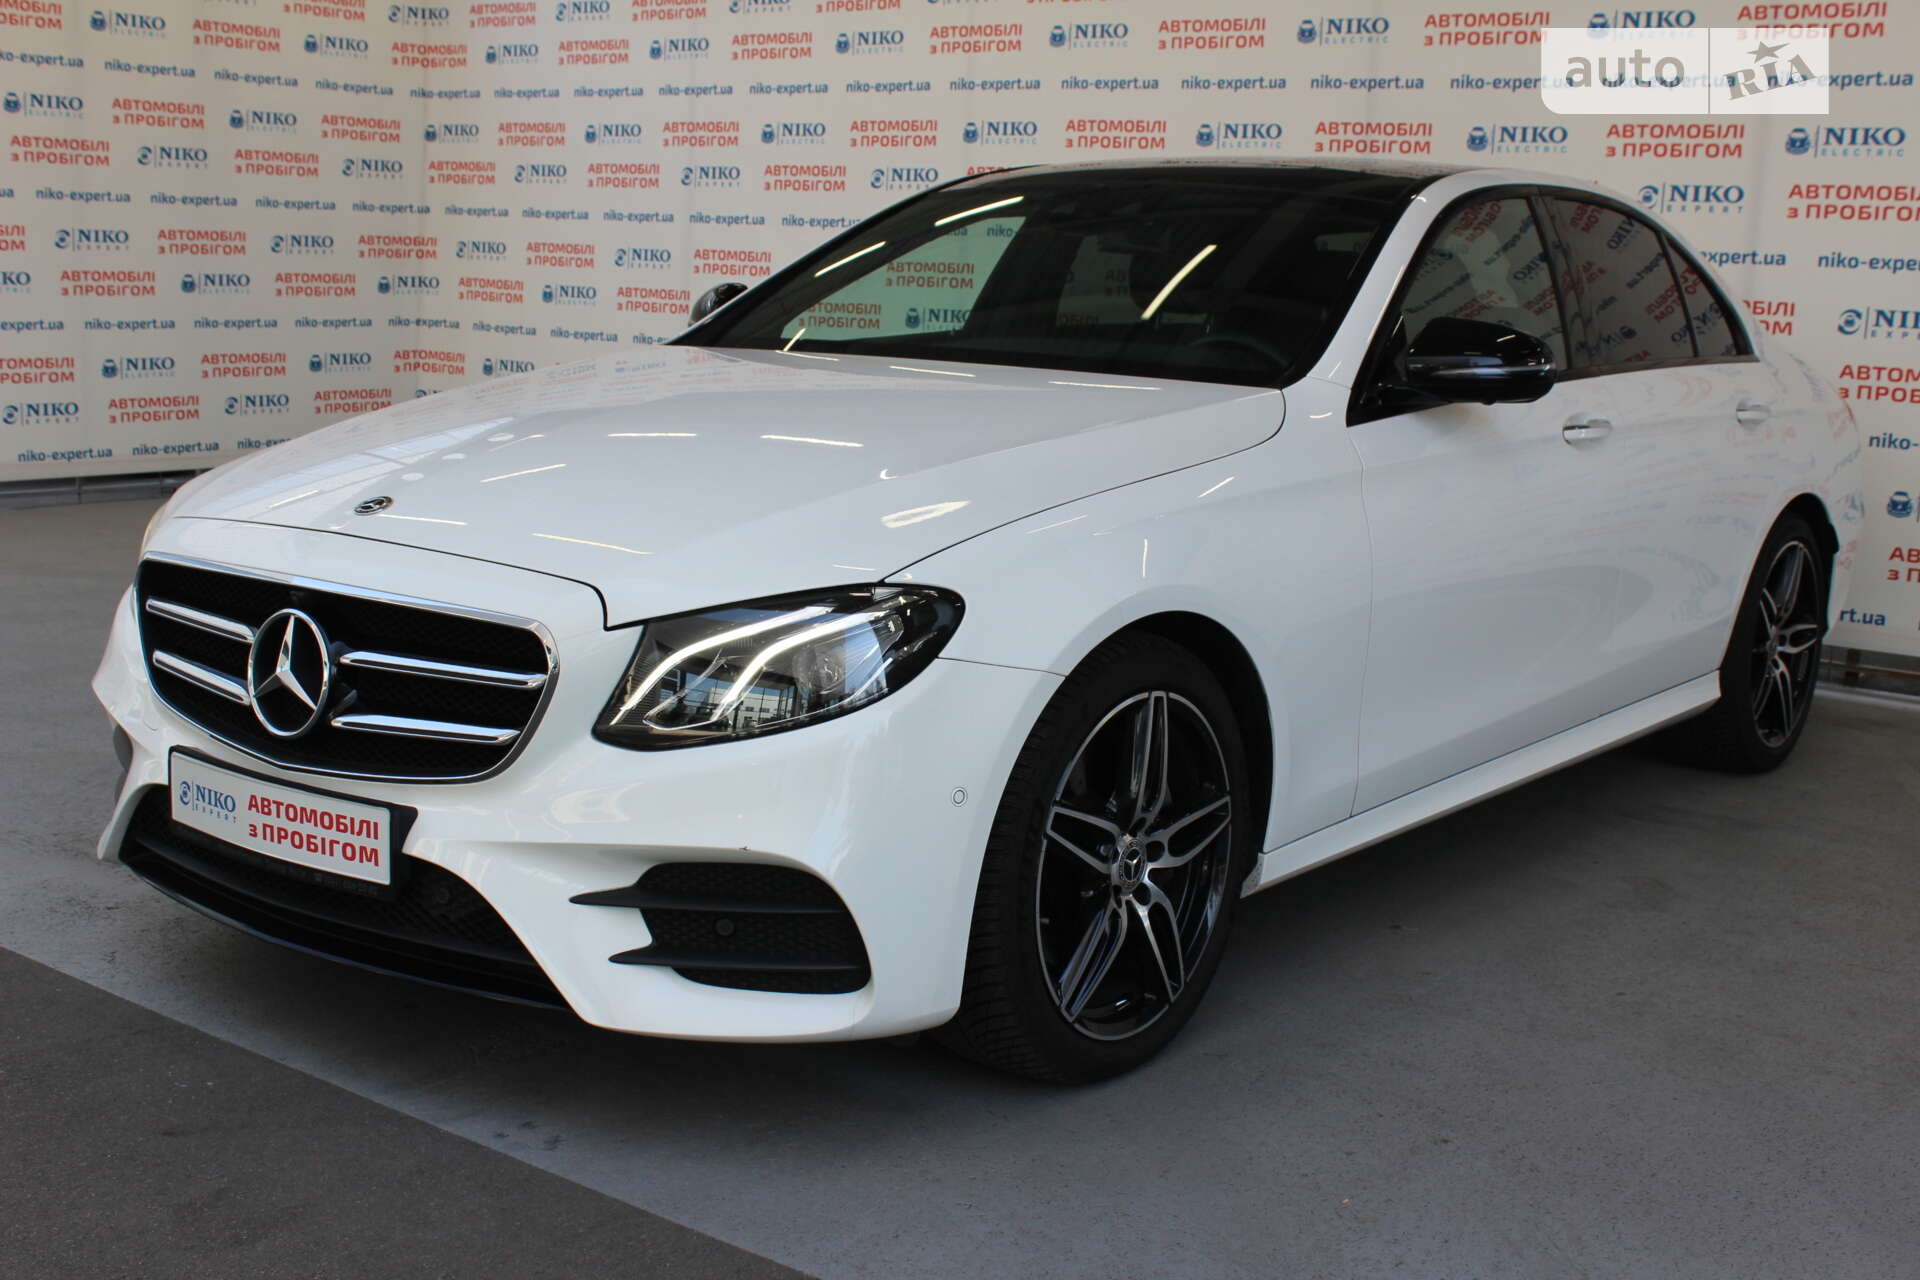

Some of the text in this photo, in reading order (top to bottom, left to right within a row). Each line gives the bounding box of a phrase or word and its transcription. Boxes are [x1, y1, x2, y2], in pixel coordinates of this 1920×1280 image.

[293, 3, 365, 22] ПРОБІГОМ
[407, 7, 450, 20] NIKO
[469, 2, 536, 16] АВТОМОБІЛІ
[571, 1, 610, 14] NIKO
[640, 7, 706, 21] ПРОБІГОМ
[1737, 1, 1887, 21] АВТОМОБІЛІ
[116, 13, 166, 30] NIKO
[477, 15, 536, 28] ПРОБІГОМ
[1158, 17, 1266, 33] АВТОМОБІЛІ
[1327, 18, 1389, 34] NIKO
[1424, 11, 1550, 28] АВТОМОБІЛІ
[1622, 10, 1696, 28] NIKO
[193, 19, 280, 40] АВТОМОБІЛІ
[929, 24, 1023, 39] АВТОМОБІЛІ
[1075, 23, 1128, 39] NIKO
[204, 34, 280, 52] ПРОБІГОМ
[326, 36, 368, 52] NIKO
[669, 38, 709, 52] NIKO
[732, 32, 813, 46] АВТОМОБІЛІ
[858, 30, 904, 46] NIKO
[1171, 34, 1264, 50] ПРОБІГОМ
[1424, 30, 1547, 47] з ПРОБІГОМ
[391, 42, 468, 56] АВТОМОБІЛІ
[502, 44, 539, 57] NIKO
[558, 39, 630, 52] АВТОМОБІЛІ
[941, 39, 1022, 54] ПРОБІГОМ
[566, 52, 629, 65] ПРОБІГОМ
[741, 47, 812, 60] ПРОБІГОМ
[104, 59, 195, 78] niko-expert.ua
[401, 55, 467, 69] ПРОБІГОМ
[214, 69, 298, 88] niko-expert.ua
[949, 78, 1040, 93] niko-expert.ua
[1061, 76, 1159, 93] niko-expert.ua
[1181, 76, 1286, 92] niko-expert.ua
[1310, 74, 1424, 92] niko-expert.ua
[315, 79, 393, 96] niko-expert.ua
[659, 85, 733, 98] niko-expert.ua
[749, 82, 828, 96] niko-expert.ua
[846, 80, 931, 95] niko-expert.ua
[30, 94, 83, 111] NIKO
[112, 98, 205, 115] АВТОМОБІЛІ
[124, 113, 204, 129] ПРОБІГОМ
[252, 111, 297, 126] NIKO
[321, 114, 401, 130] АВТОМОБІЛІ
[444, 124, 479, 137] NIKO
[498, 122, 566, 134] АВТОМОБІЛІ
[603, 124, 642, 137] NIKO
[662, 120, 740, 134] АВТОМОБІЛІ
[782, 123, 826, 137] NIKO
[850, 119, 938, 133] АВТОМОБІЛІ
[987, 121, 1037, 136] NIKO
[1065, 119, 1167, 133] АВТОМОБІЛІ
[1224, 123, 1282, 139] NIKO
[1315, 121, 1433, 137] АВТОМОБІЛІ
[1606, 123, 1745, 139] АВТОМОБІЛІ
[331, 128, 400, 143] ПРОБІГОМ
[506, 135, 565, 147] ПРОБІГОМ
[672, 135, 739, 147] ПРОБІГОМ
[1500, 125, 1568, 143] NIKO
[1824, 127, 1906, 146] NIKO
[10, 135, 110, 152] АВТОМОБІЛІ
[860, 135, 937, 148] ПРОБІГОМ
[1077, 135, 1165, 150] ПРОБІГОМ
[1315, 139, 1431, 155] з ПРОБІГОМ
[24, 150, 110, 166] ПРОБІГОМ
[160, 147, 208, 161] NIKO
[235, 149, 319, 164] АВТОМОБІЛІ
[1605, 143, 1742, 159] з ПРОБІГОМ
[245, 163, 319, 177] ПРОБІГОМ
[361, 159, 403, 173] NIKO
[428, 161, 496, 172] АВТОМОБІЛІ
[530, 164, 567, 177] NIKO
[587, 163, 660, 175] АВТОМОБІЛІ
[699, 166, 740, 180] NIKO
[764, 164, 847, 177] АВТОМОБІЛІ
[438, 173, 496, 185] ПРОБІГОМ
[892, 168, 939, 182] NIKO
[595, 176, 659, 189] ПРОБІГОМ
[774, 179, 846, 192] ПРОБІГОМ
[35, 188, 131, 203] niko-expert.ua
[150, 193, 237, 207] niko-expert.ua
[1669, 184, 1745, 203] NIKO
[603, 210, 674, 224] niko-expert.ua
[689, 212, 765, 227] niko-expert.ua
[1786, 207, 1798, 219] з
[78, 229, 129, 243] NIKO
[157, 229, 247, 242] АВТОМОБІЛІ
[291, 235, 334, 248] NIKO
[358, 235, 438, 248] АВТОМОБІЛІ
[169, 243, 246, 256] ПРОБІГОМ
[367, 247, 437, 260] ПРОБІГОМ
[472, 241, 507, 255] NIKO
[526, 242, 595, 255] АВТОМОБІЛІ
[632, 248, 671, 262] NIKO
[534, 255, 594, 268] ПРОБІГОМ
[693, 249, 772, 263] АВТОМОБІЛІ
[702, 263, 770, 277] ПРОБІГОМ
[887, 261, 975, 274] АВТОМОБІЛІ
[60, 270, 156, 283] АВТОМОБІЛІ
[204, 274, 251, 287] NIKO
[275, 272, 356, 284] АВТОМОБІЛІ
[397, 276, 440, 289] NIKO
[896, 275, 974, 289] ПРОБІГОМ
[73, 284, 155, 297] ПРОБІГОМ
[285, 285, 356, 297] ПРОБІГОМ
[458, 277, 524, 291] АВТОМОБІЛІ
[465, 290, 523, 304] ПРОБІГОМ
[560, 285, 597, 299] NIKO
[617, 287, 690, 301] АВТОМОБІЛІ
[625, 300, 689, 315] ПРОБІГОМ
[84, 319, 176, 332] niko-expert.ua
[194, 317, 278, 330] niko-expert.ua
[473, 321, 537, 336] niko-expert.ua
[550, 327, 618, 342] niko-expert.ua
[201, 352, 287, 365] АВТОМОБІЛІ
[330, 352, 372, 365] NIKO
[394, 349, 466, 363] АВТОМОБІЛІ
[126, 357, 175, 371] NIKO
[403, 361, 465, 376] ПРОБІГОМ
[212, 365, 286, 378] ПРОБІГОМ
[245, 394, 290, 408] NIKO
[314, 388, 392, 401] АВТОМОБІЛІ
[26, 402, 79, 417] NIKO
[108, 395, 200, 410] АВТОМОБІЛІ
[120, 408, 200, 423] ПРОБІГОМ
[17, 448, 113, 462] niko-expert.ua
[132, 442, 220, 456] niko-expert.ua
[195, 784, 236, 813] NIKO
[248, 794, 379, 840] АВТОМОБІЛІ
[249, 823, 380, 867] з ПРОБІГОМ
